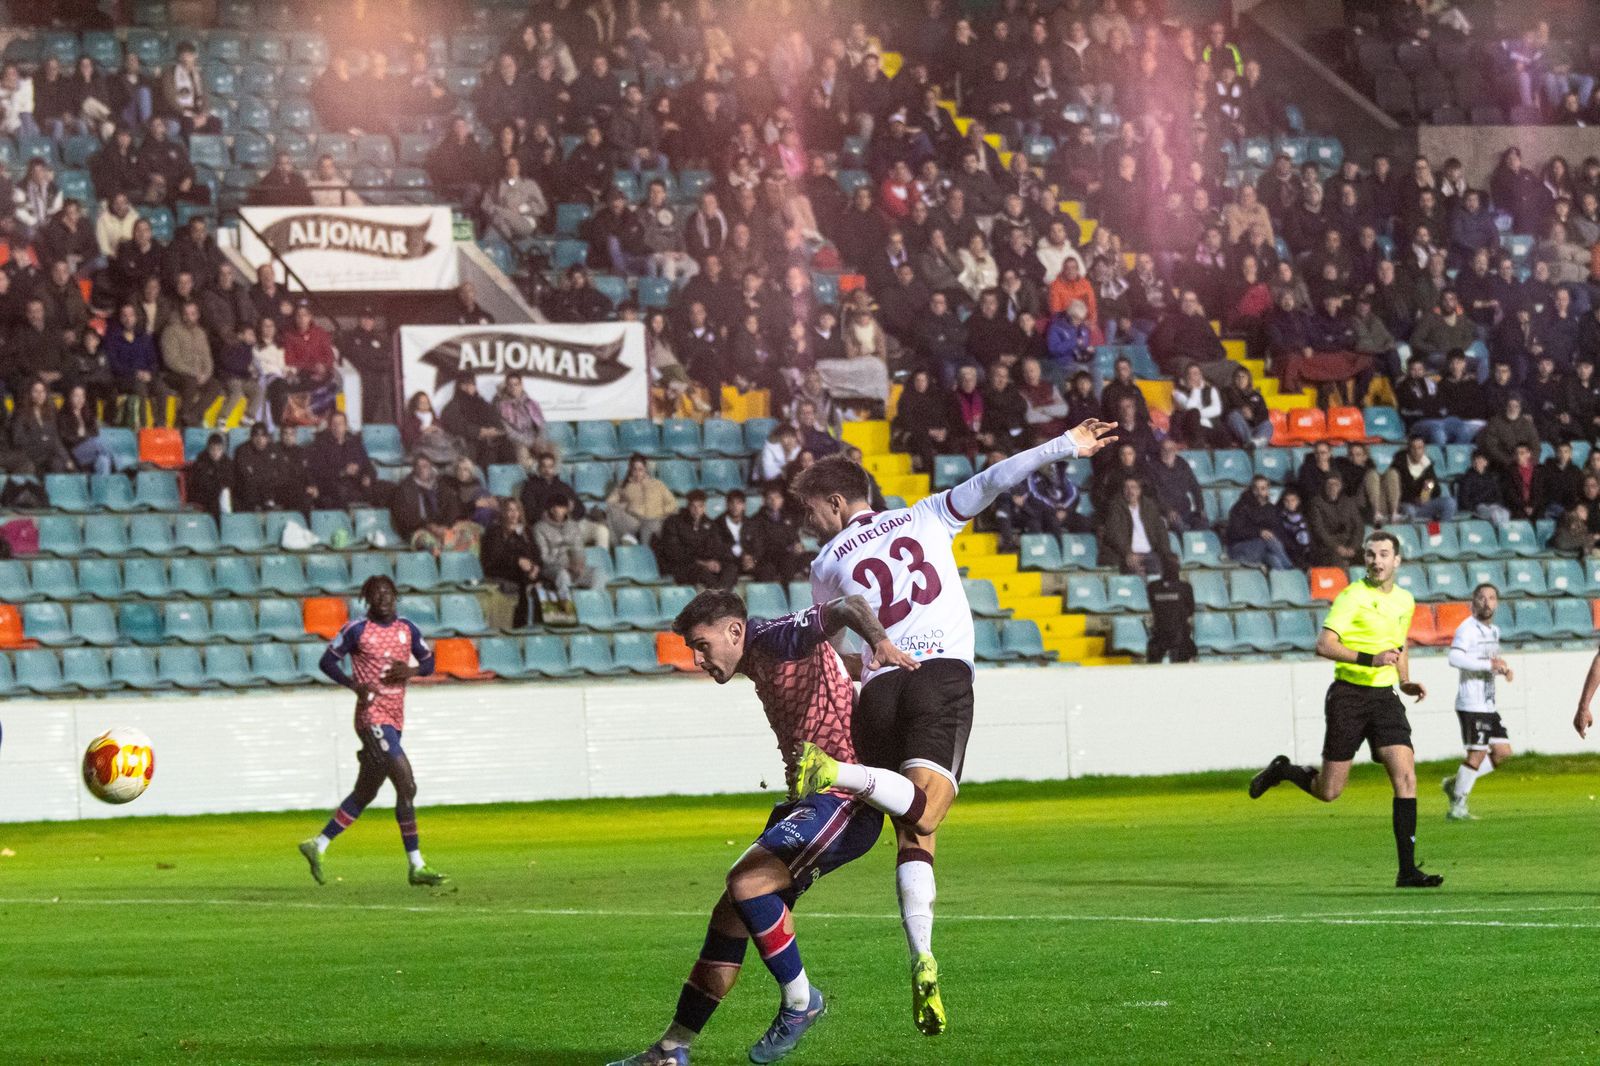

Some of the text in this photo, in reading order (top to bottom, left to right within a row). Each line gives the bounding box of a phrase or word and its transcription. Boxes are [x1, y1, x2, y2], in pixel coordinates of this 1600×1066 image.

[288, 220, 408, 255] ALJOMAR
[458, 340, 599, 379] ALJOMAR
[833, 513, 912, 562] JAVI DELGADO
[852, 536, 942, 630] 23
